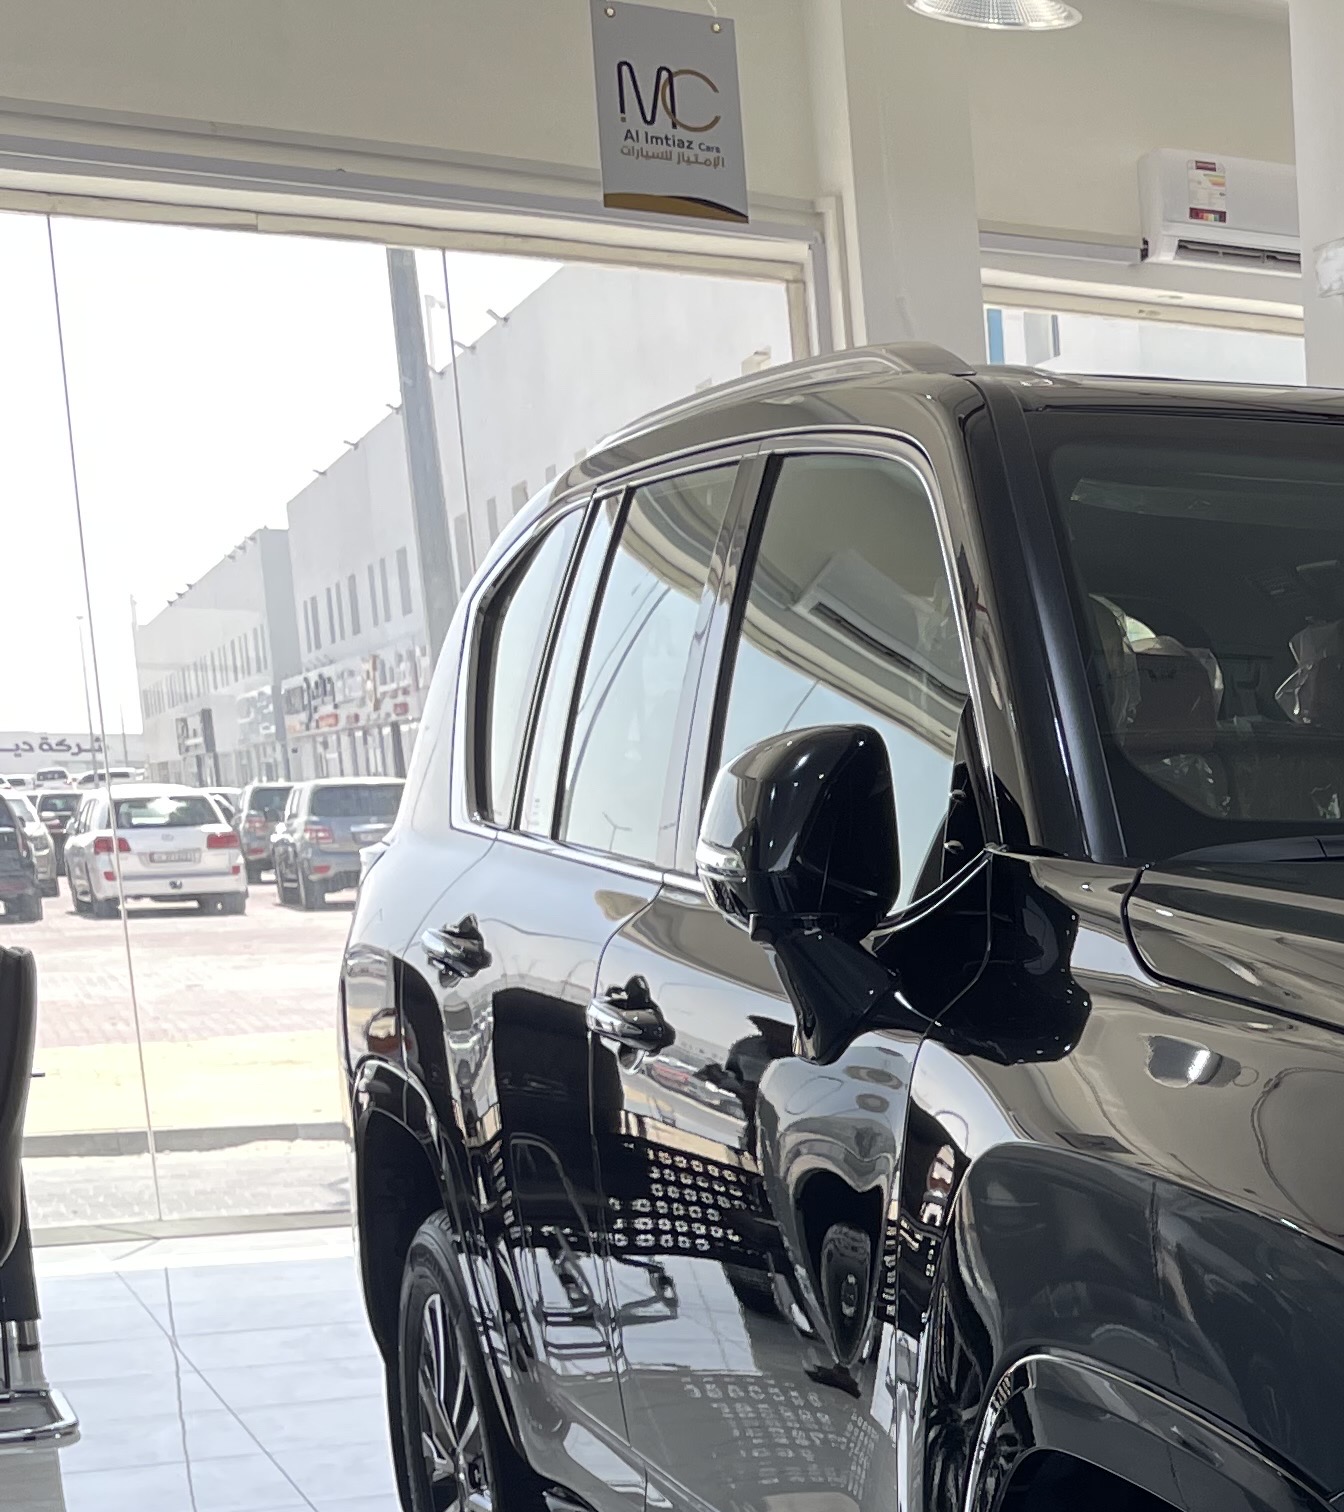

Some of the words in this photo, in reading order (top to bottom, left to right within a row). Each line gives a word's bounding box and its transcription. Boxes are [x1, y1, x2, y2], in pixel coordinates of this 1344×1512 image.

[624, 129, 640, 143] Al
[645, 131, 694, 150] Imtiaz
[698, 142, 721, 154] Cars
